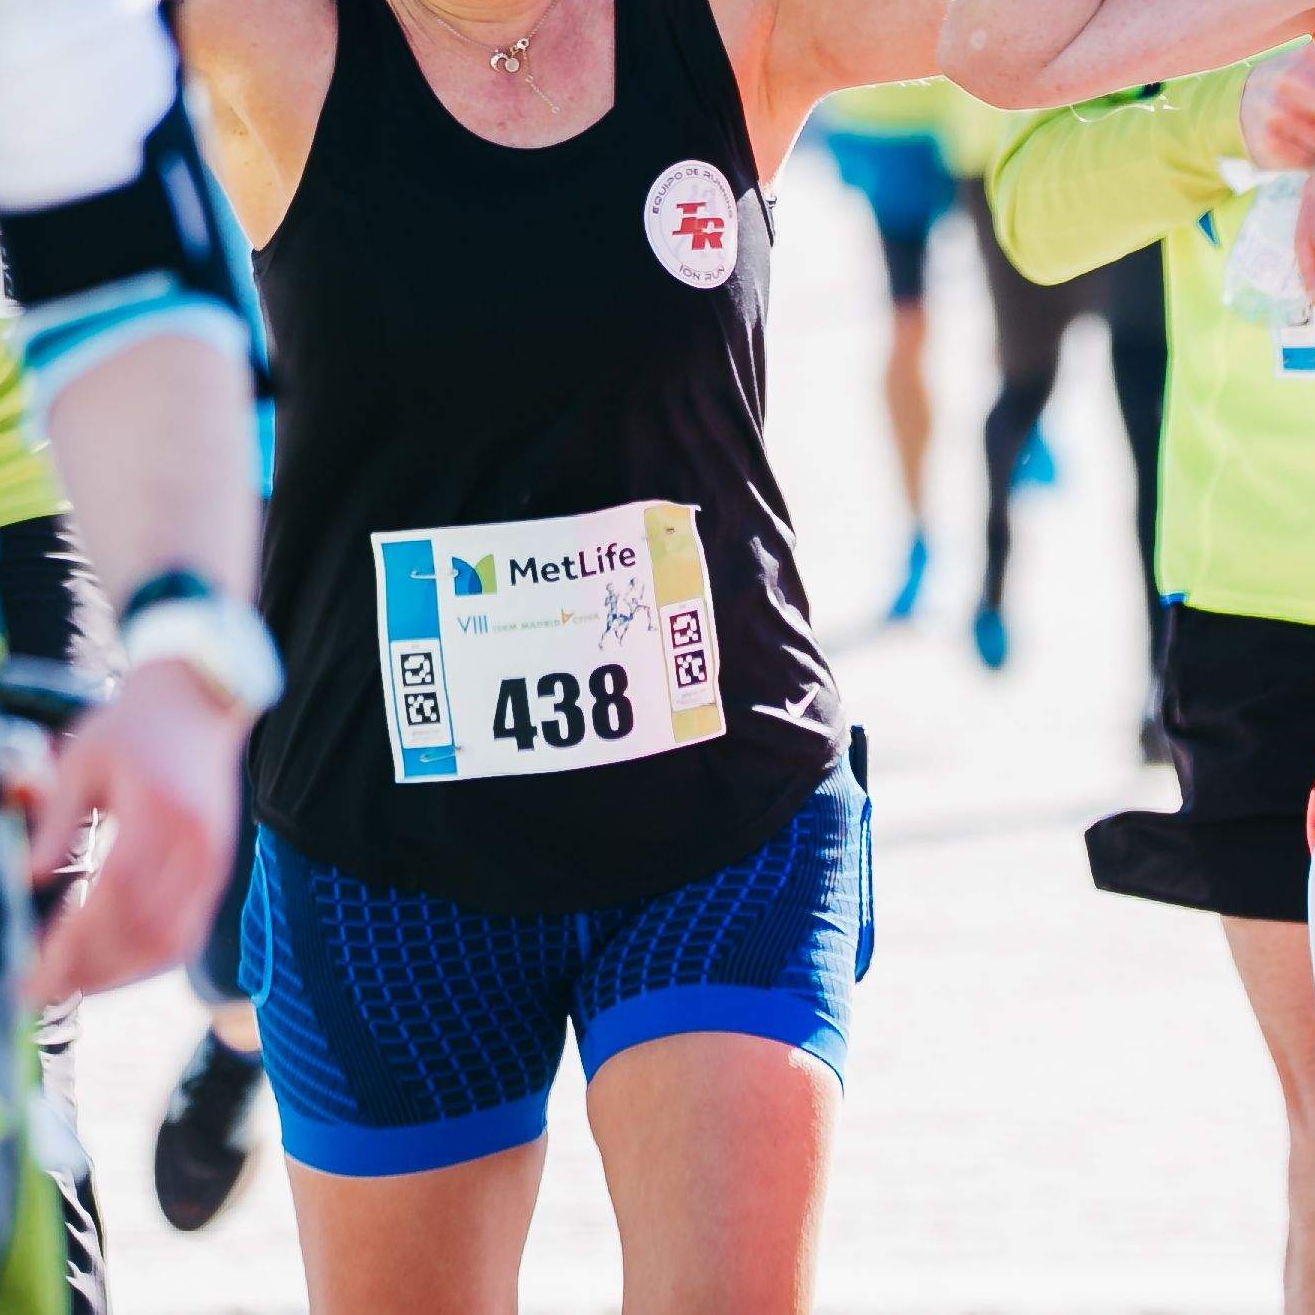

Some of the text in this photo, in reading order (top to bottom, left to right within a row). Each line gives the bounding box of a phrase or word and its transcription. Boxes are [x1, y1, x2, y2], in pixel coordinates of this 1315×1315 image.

[652, 171, 683, 215] EQUIPO
[686, 168, 699, 176] DE
[510, 544, 636, 585] MetLife
[457, 614, 489, 635] VIII
[493, 663, 634, 751] 438
